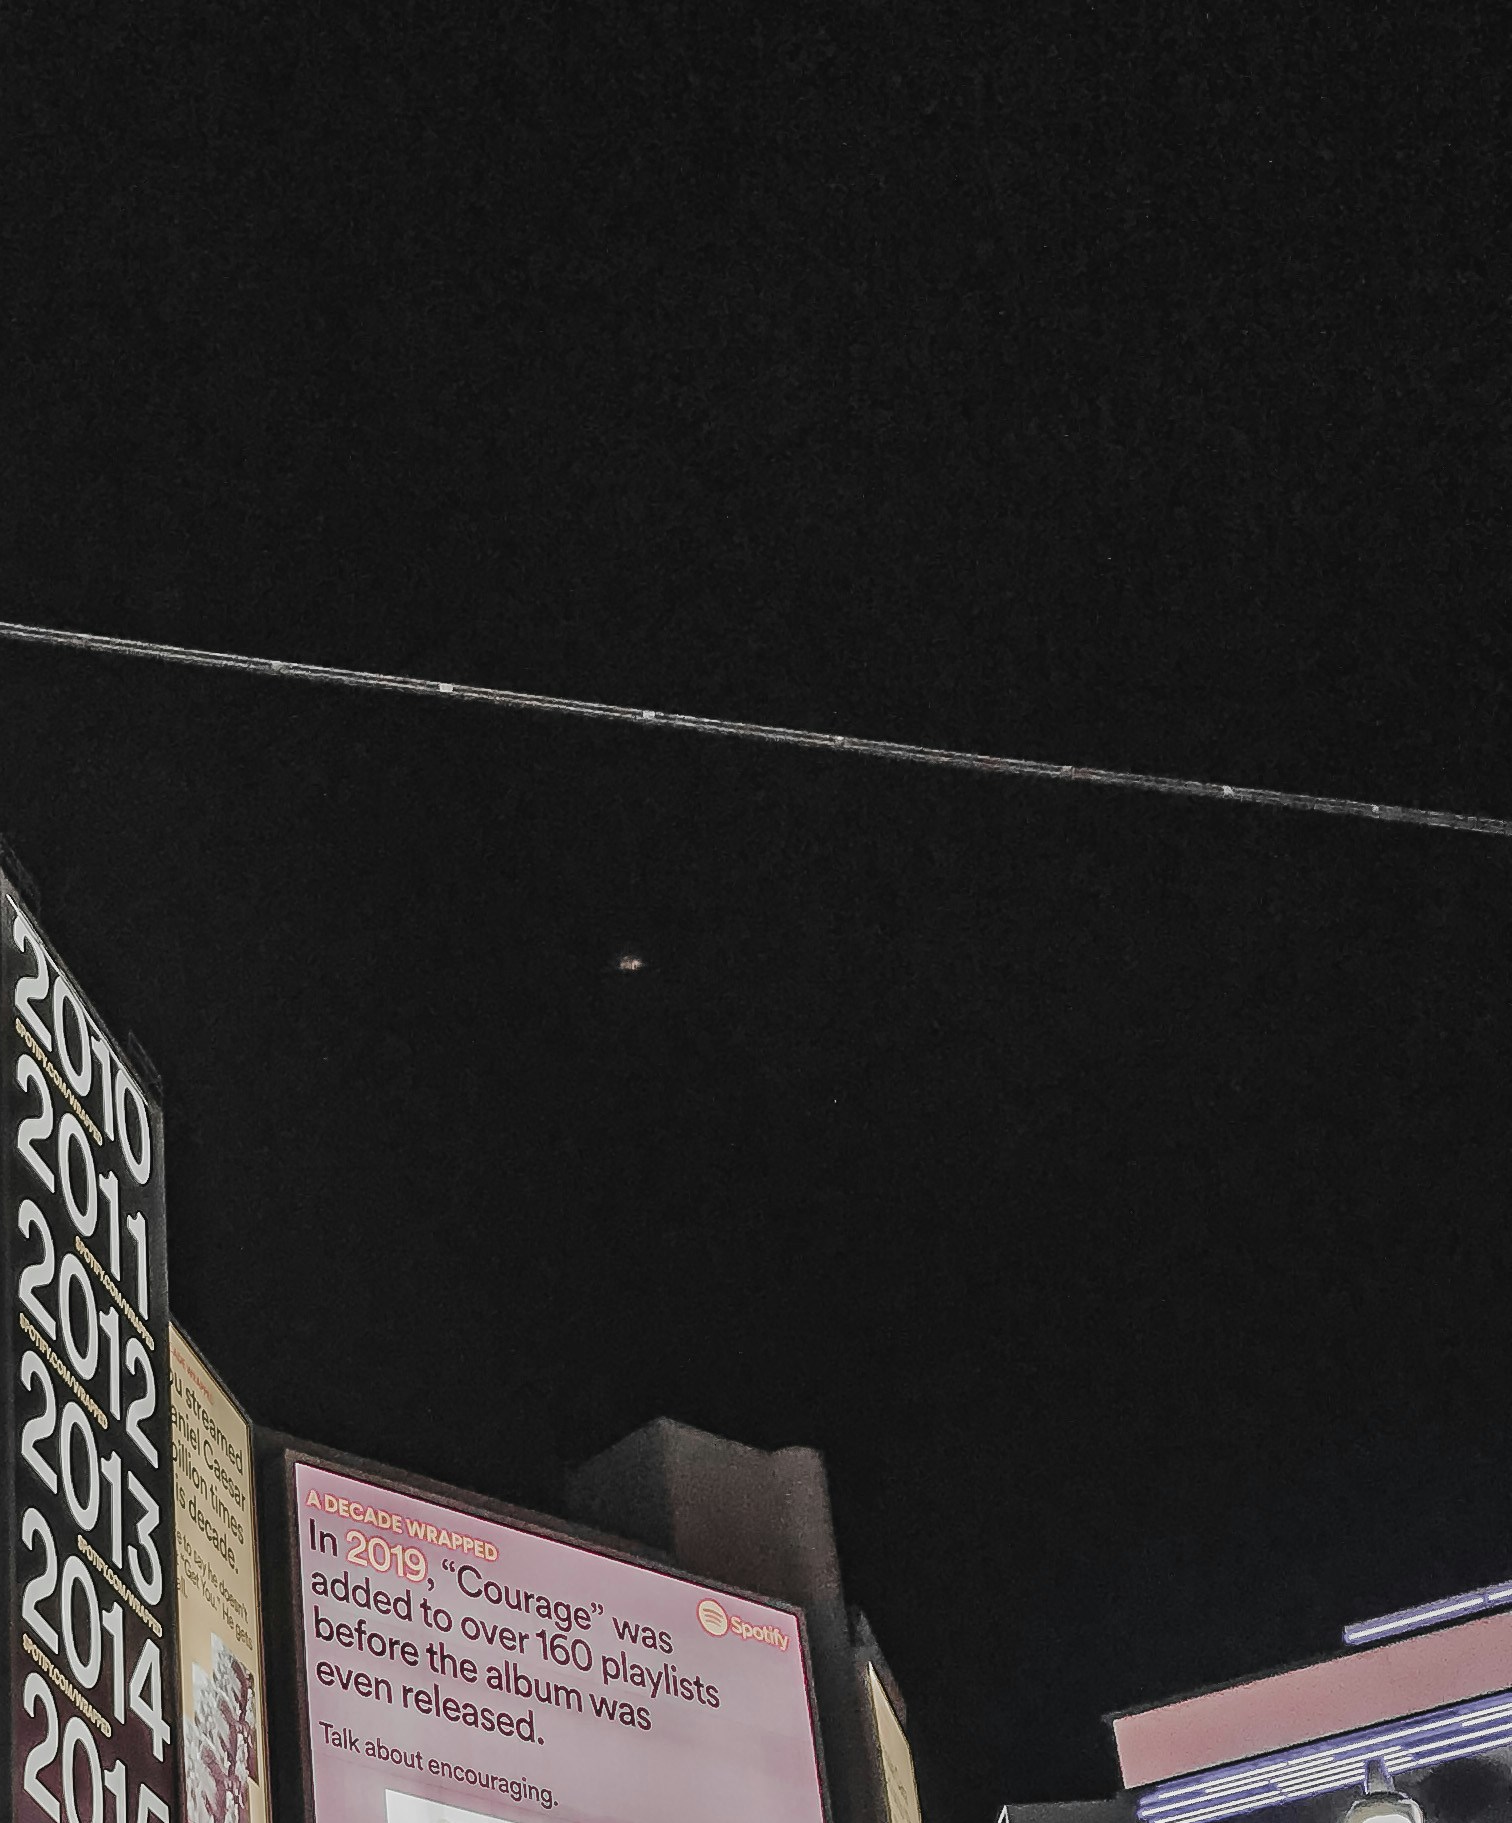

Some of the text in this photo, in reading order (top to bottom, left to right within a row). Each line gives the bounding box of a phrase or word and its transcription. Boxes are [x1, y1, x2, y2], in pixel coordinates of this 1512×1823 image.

[13, 914, 151, 1185] 2010
[17, 1053, 150, 1321] 2011
[18, 1198, 159, 1469] 2012
[20, 1349, 163, 1606] 2013
[186, 1382, 244, 1476] streamed
[203, 1438, 246, 1512] Caesar
[189, 1500, 239, 1575] decade.
[209, 1485, 245, 1546] times
[305, 1490, 499, 1562] A DECADE WRAPPED
[21, 1506, 171, 1763] 2014
[308, 1518, 338, 1558] In
[345, 1530, 435, 1591] 2019,
[612, 1615, 674, 1655] was
[311, 1570, 722, 1710] added to over 160 playlists
[728, 1613, 791, 1654] Spotify
[313, 1605, 653, 1732] before the album was
[316, 1660, 546, 1747] even released.
[318, 1721, 559, 1809] Talk about encouraging.
